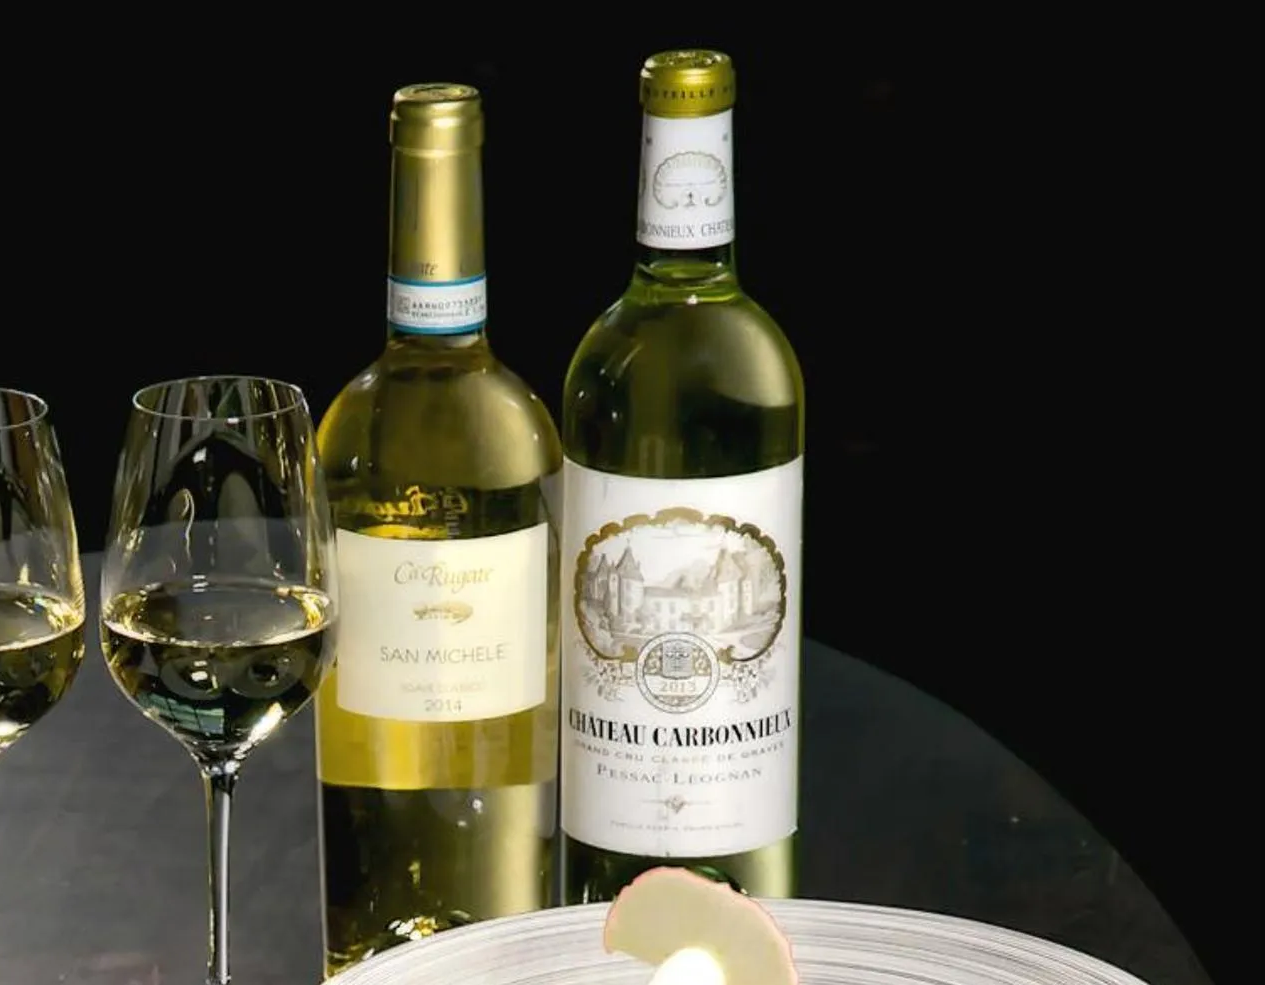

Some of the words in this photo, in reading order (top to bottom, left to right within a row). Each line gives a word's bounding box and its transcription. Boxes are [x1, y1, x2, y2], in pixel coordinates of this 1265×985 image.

[380, 645, 420, 663] SAN
[426, 642, 507, 664] MICHELE
[424, 699, 462, 712] 2014
[652, 706, 792, 748] CARBONNIEUX
